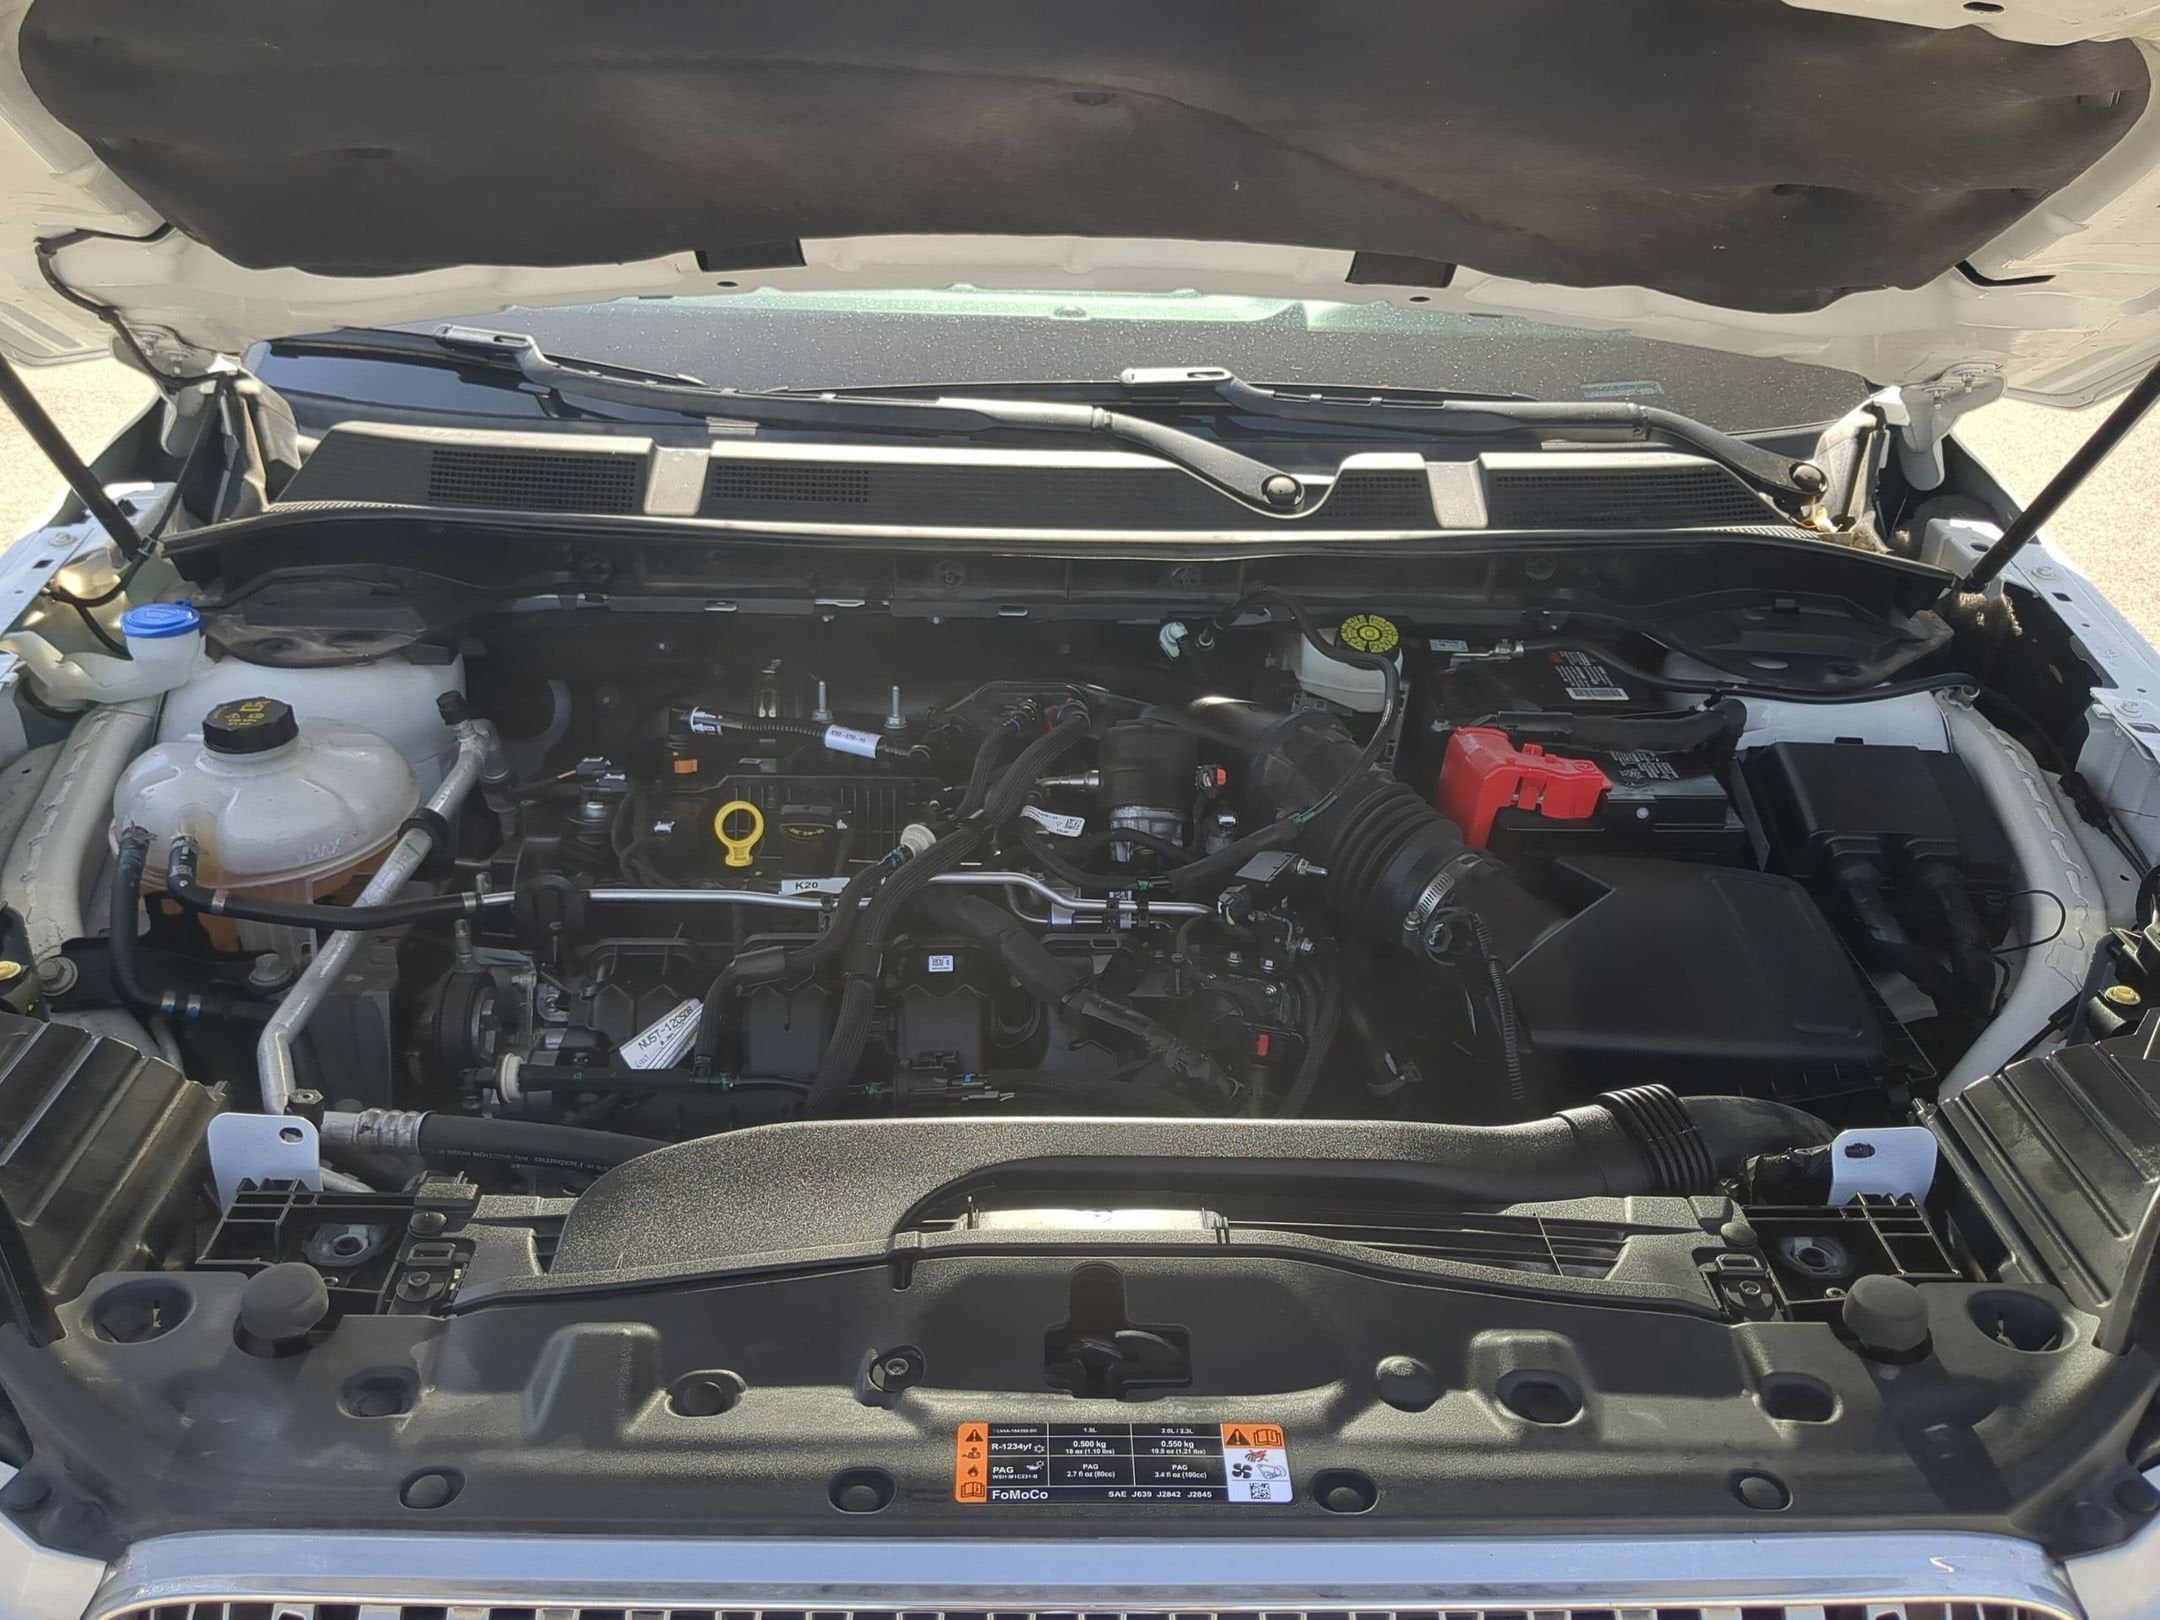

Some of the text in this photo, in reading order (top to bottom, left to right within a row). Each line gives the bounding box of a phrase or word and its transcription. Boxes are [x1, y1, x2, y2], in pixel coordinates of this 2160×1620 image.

[795, 881, 819, 890] K20
[991, 1443, 1032, 1451] R-1234yf
[1073, 1440, 1107, 1448] 0.500 kg
[1160, 1440, 1195, 1448] 0.550 kg
[992, 1466, 1014, 1474] PAG
[1182, 1471, 1207, 1479] (100cc)
[992, 1490, 1048, 1500] FoMoCo
